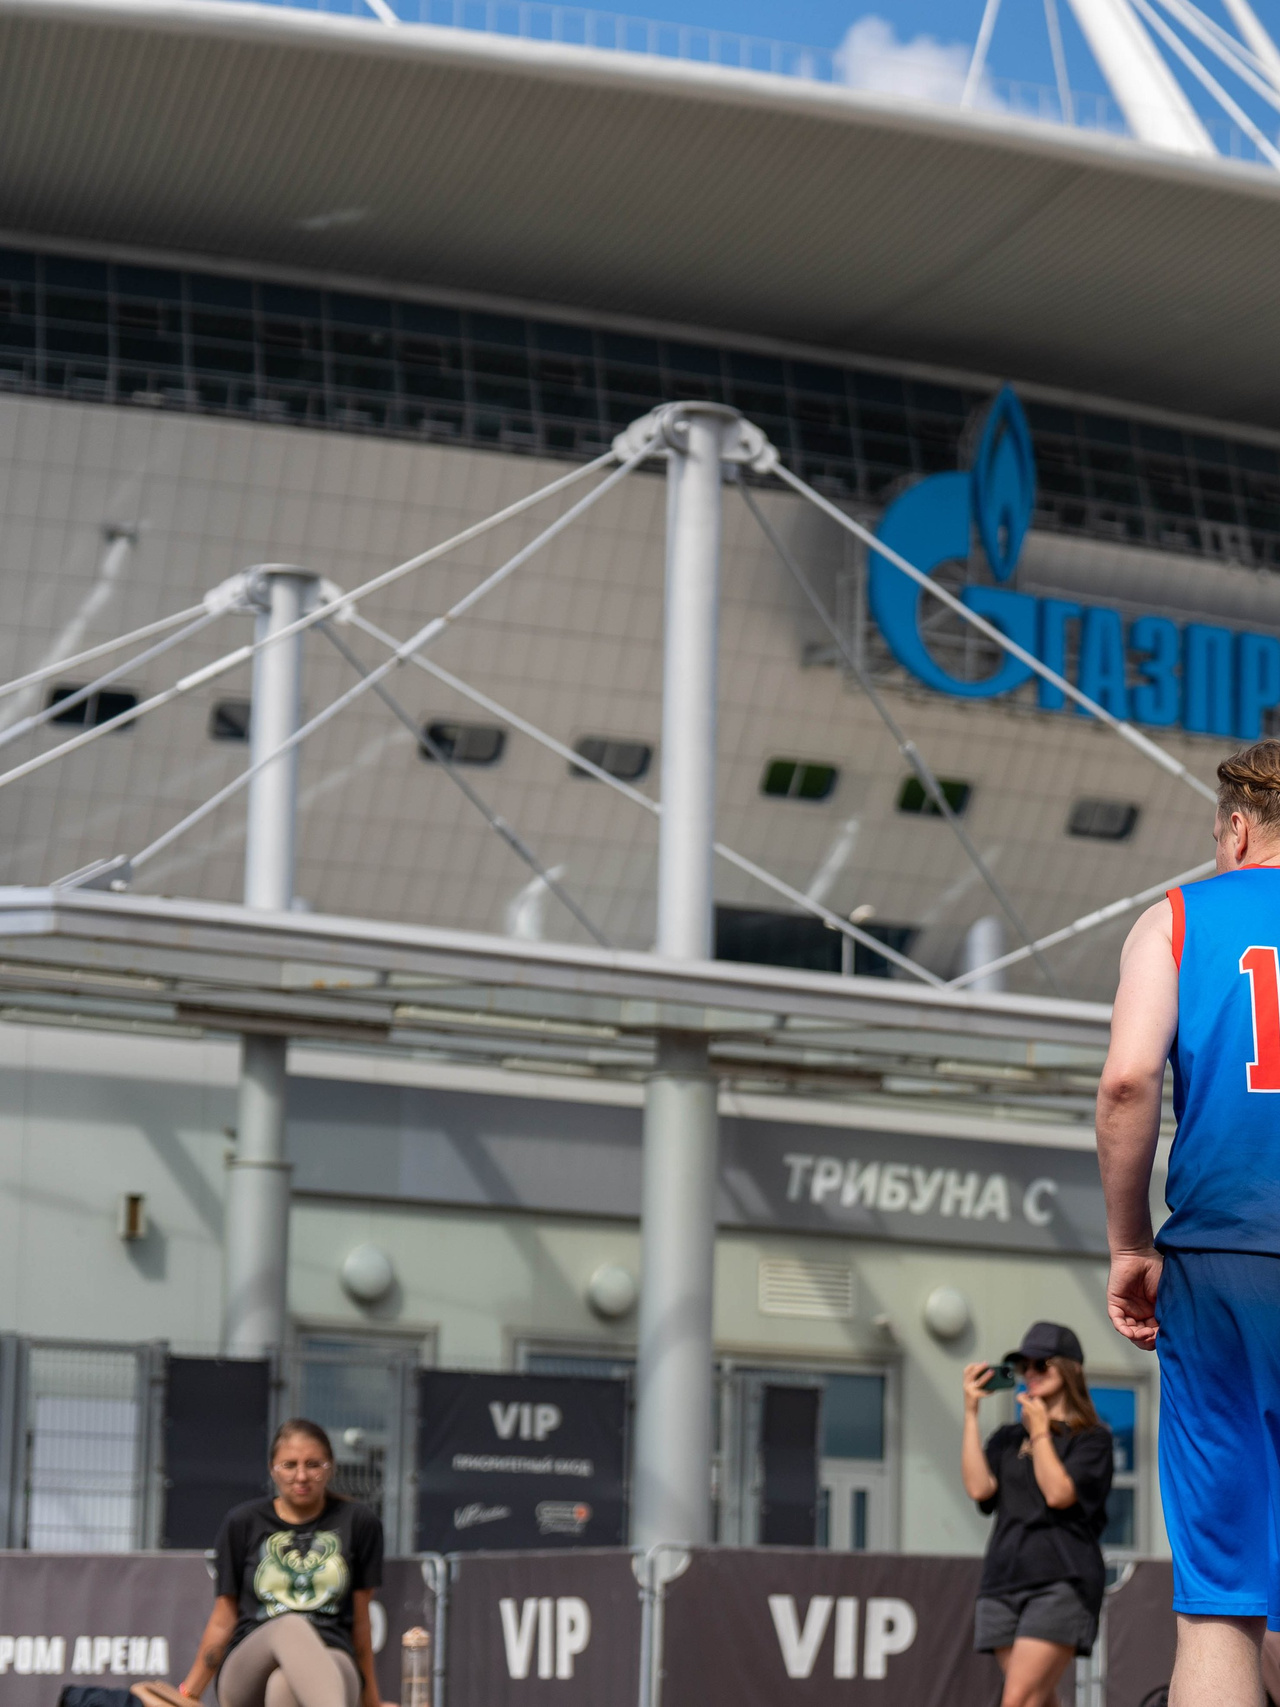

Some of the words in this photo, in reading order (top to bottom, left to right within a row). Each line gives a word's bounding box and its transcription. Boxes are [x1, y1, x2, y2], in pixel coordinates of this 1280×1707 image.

[783, 1153, 1011, 1223] ТРИБУНА
[488, 1400, 562, 1441] VIP
[71, 1635, 170, 1675] АРЕНА
[499, 1596, 591, 1679] VIP
[767, 1593, 918, 1680] VIP
